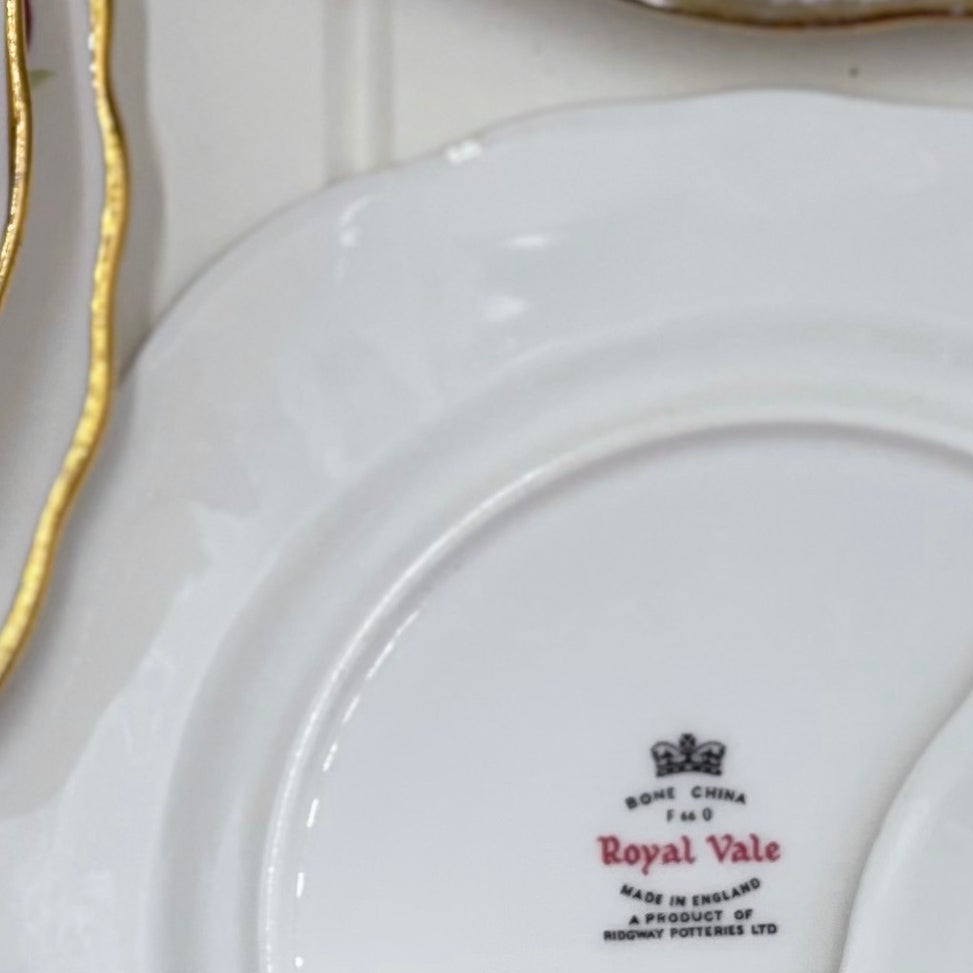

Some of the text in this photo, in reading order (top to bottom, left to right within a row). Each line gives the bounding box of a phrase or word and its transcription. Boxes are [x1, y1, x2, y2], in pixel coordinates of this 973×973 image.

[625, 786, 747, 810] BONE CHINA
[597, 833, 781, 876] Royal Vale
[620, 878, 760, 906] MADE IN ENGLAND
[629, 909, 753, 925] A PRODUCT OF
[603, 923, 777, 941] RIDGWAY POTTERIES LTD
